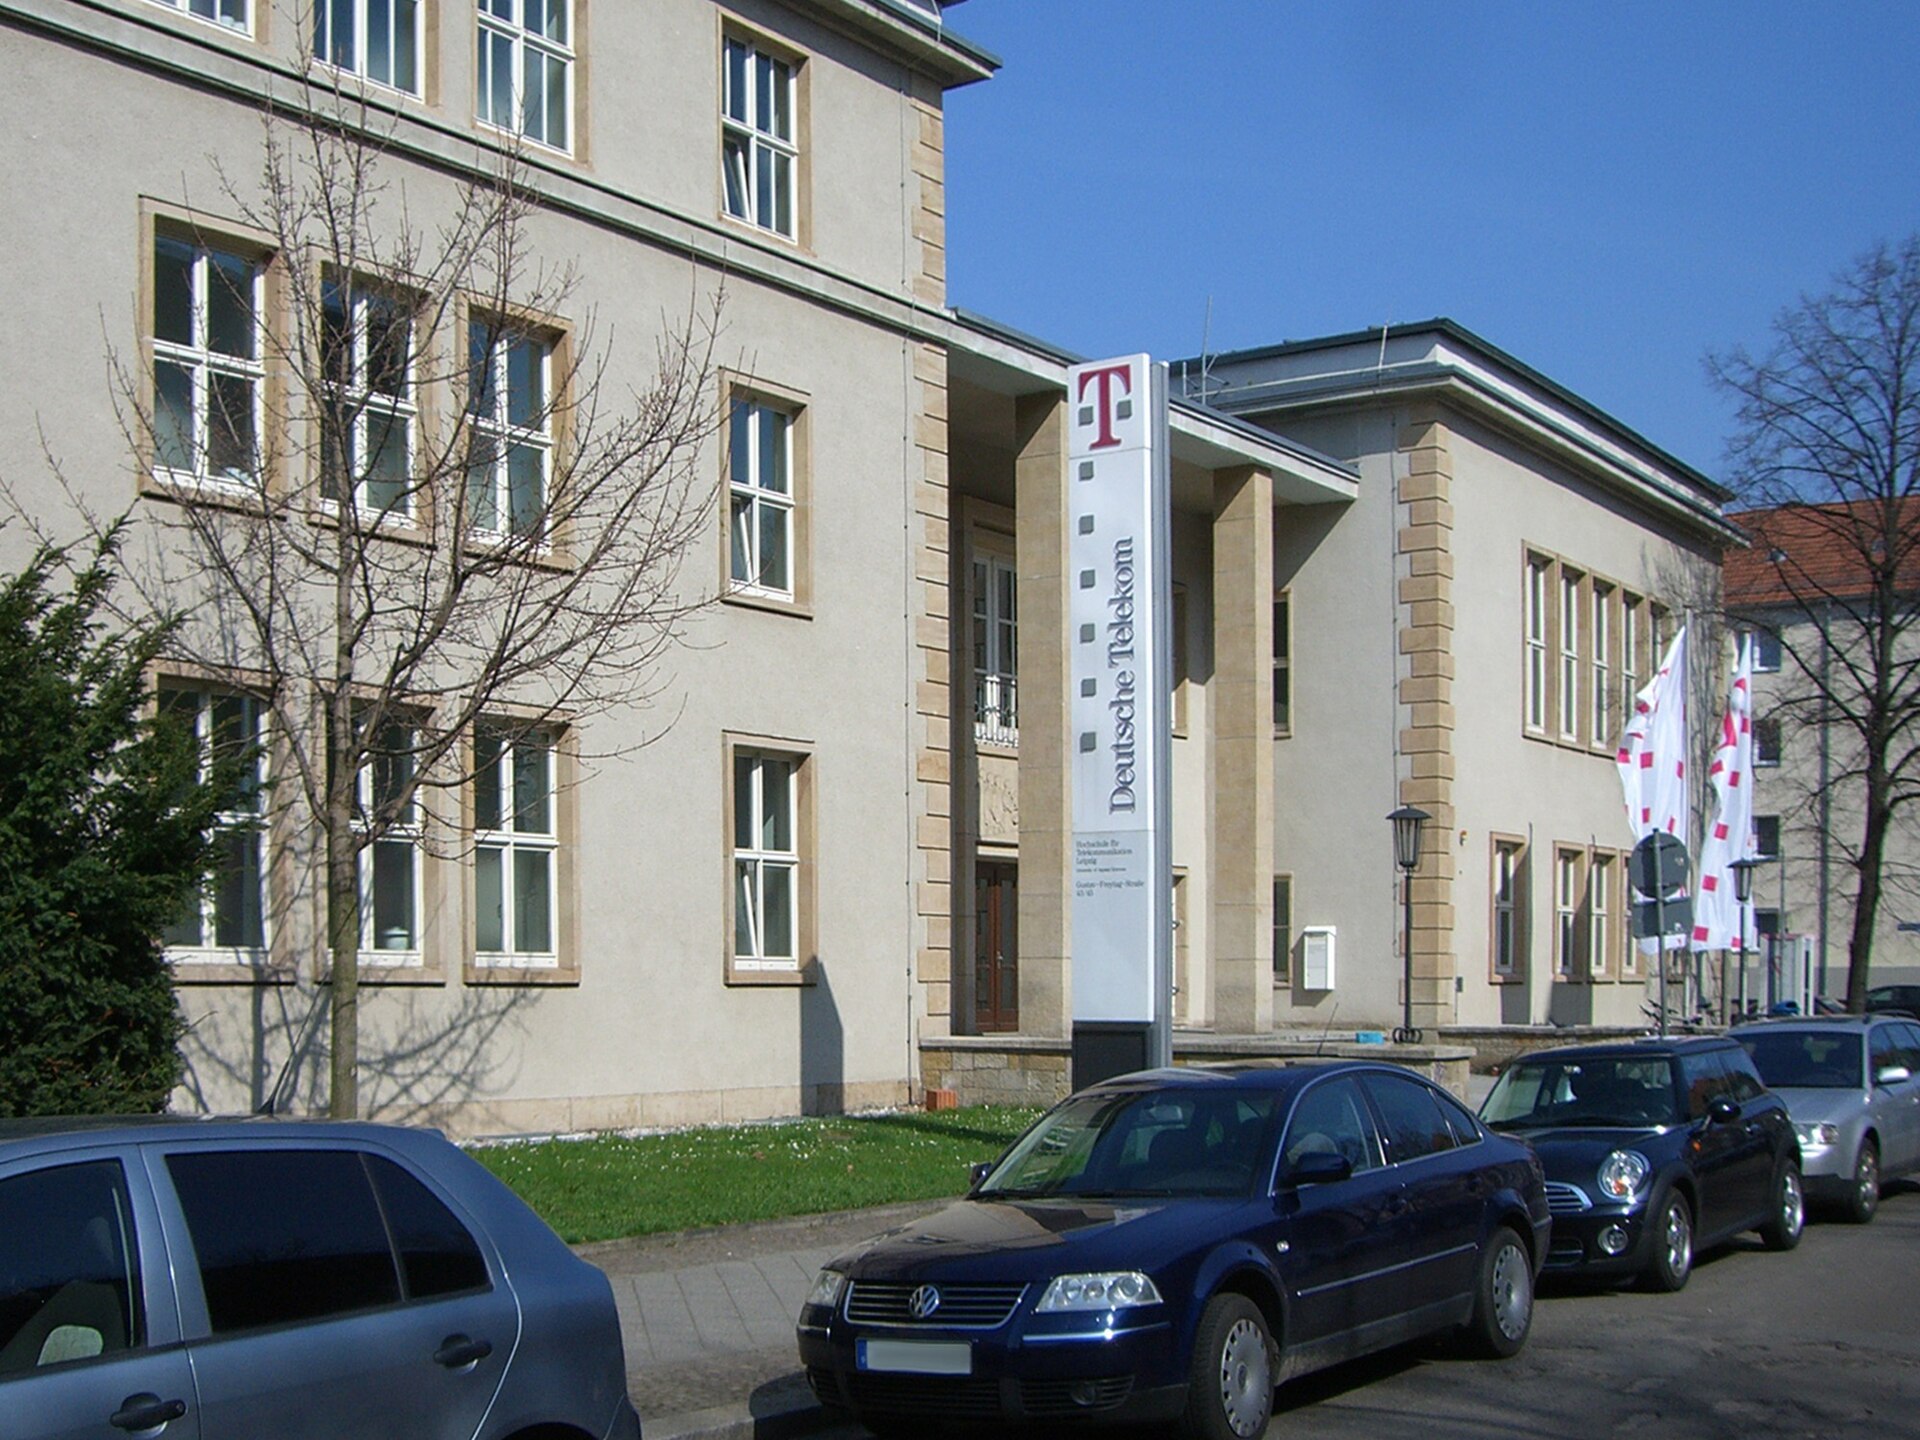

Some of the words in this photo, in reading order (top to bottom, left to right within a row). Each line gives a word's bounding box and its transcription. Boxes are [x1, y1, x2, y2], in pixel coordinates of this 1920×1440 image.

[1078, 364, 1131, 450] T
[1108, 536, 1134, 668] Telekom
[1109, 670, 1135, 815] Deutsche
